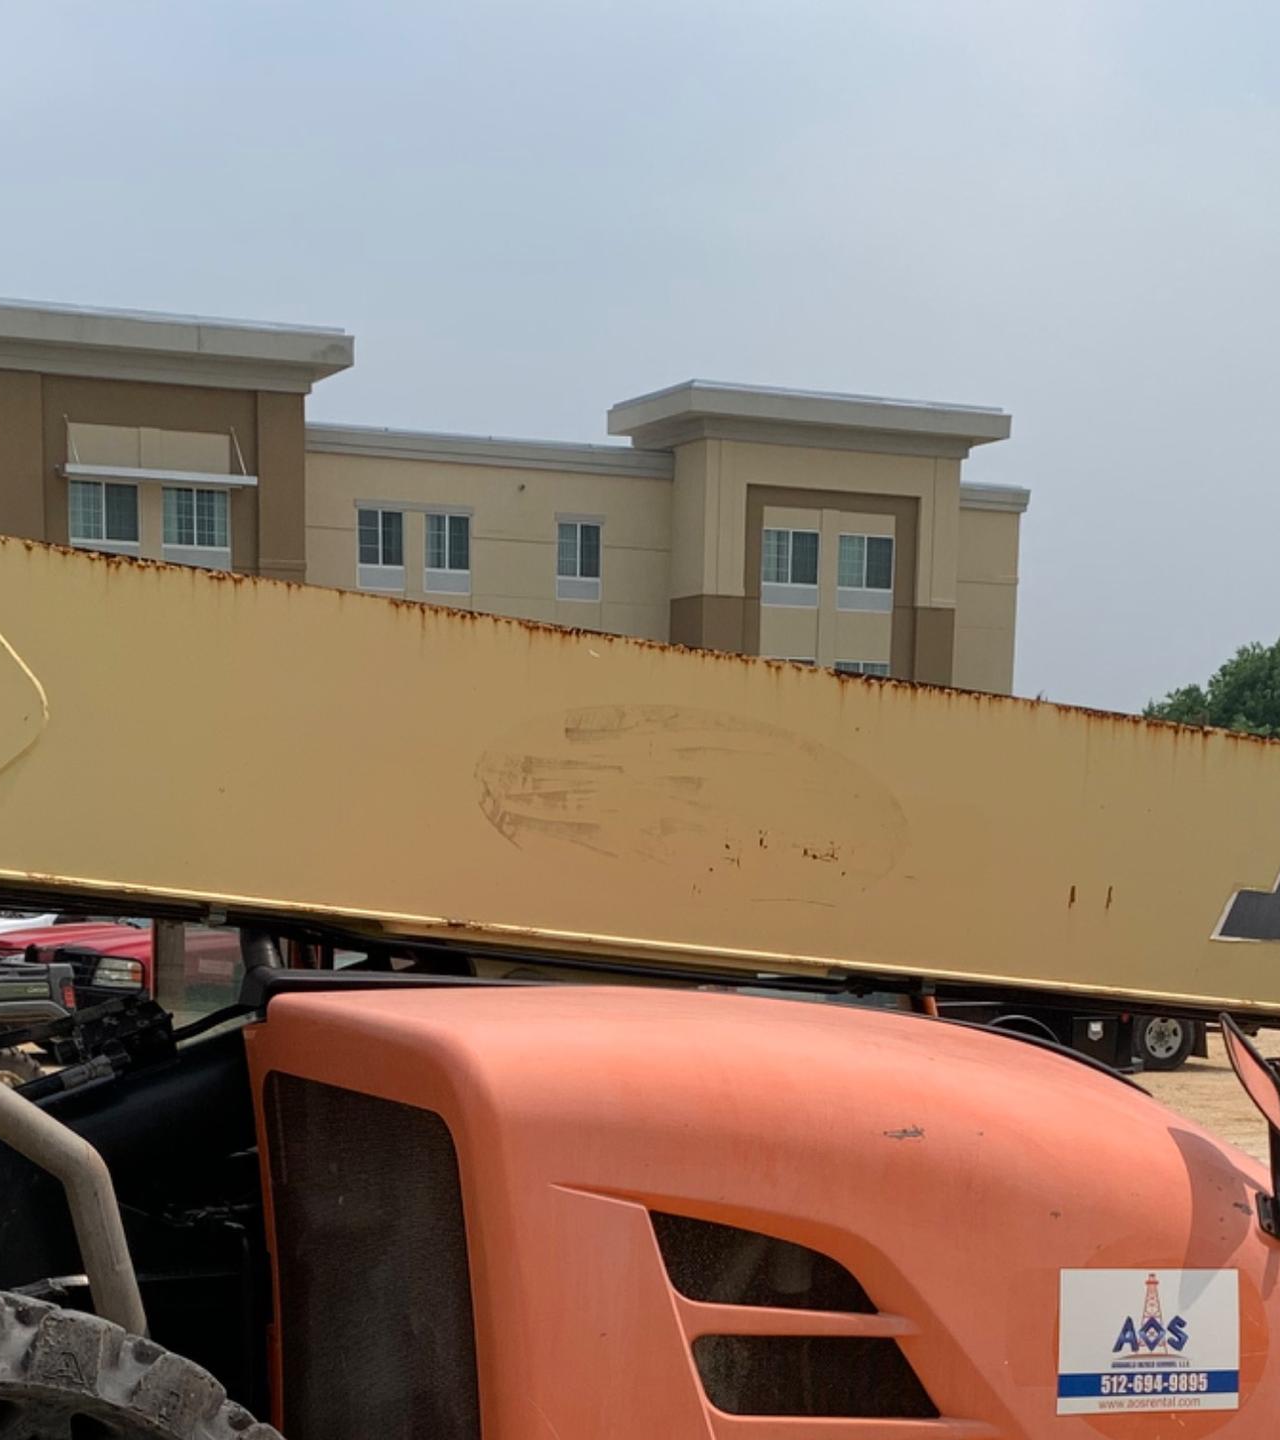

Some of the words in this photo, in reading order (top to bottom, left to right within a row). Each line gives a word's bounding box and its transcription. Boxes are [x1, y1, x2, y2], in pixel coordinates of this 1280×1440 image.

[1112, 1314, 1189, 1353] AOS
[1101, 1373, 1209, 1394] 512-694-9895
[1098, 1396, 1201, 1410] www.aosrental.com
